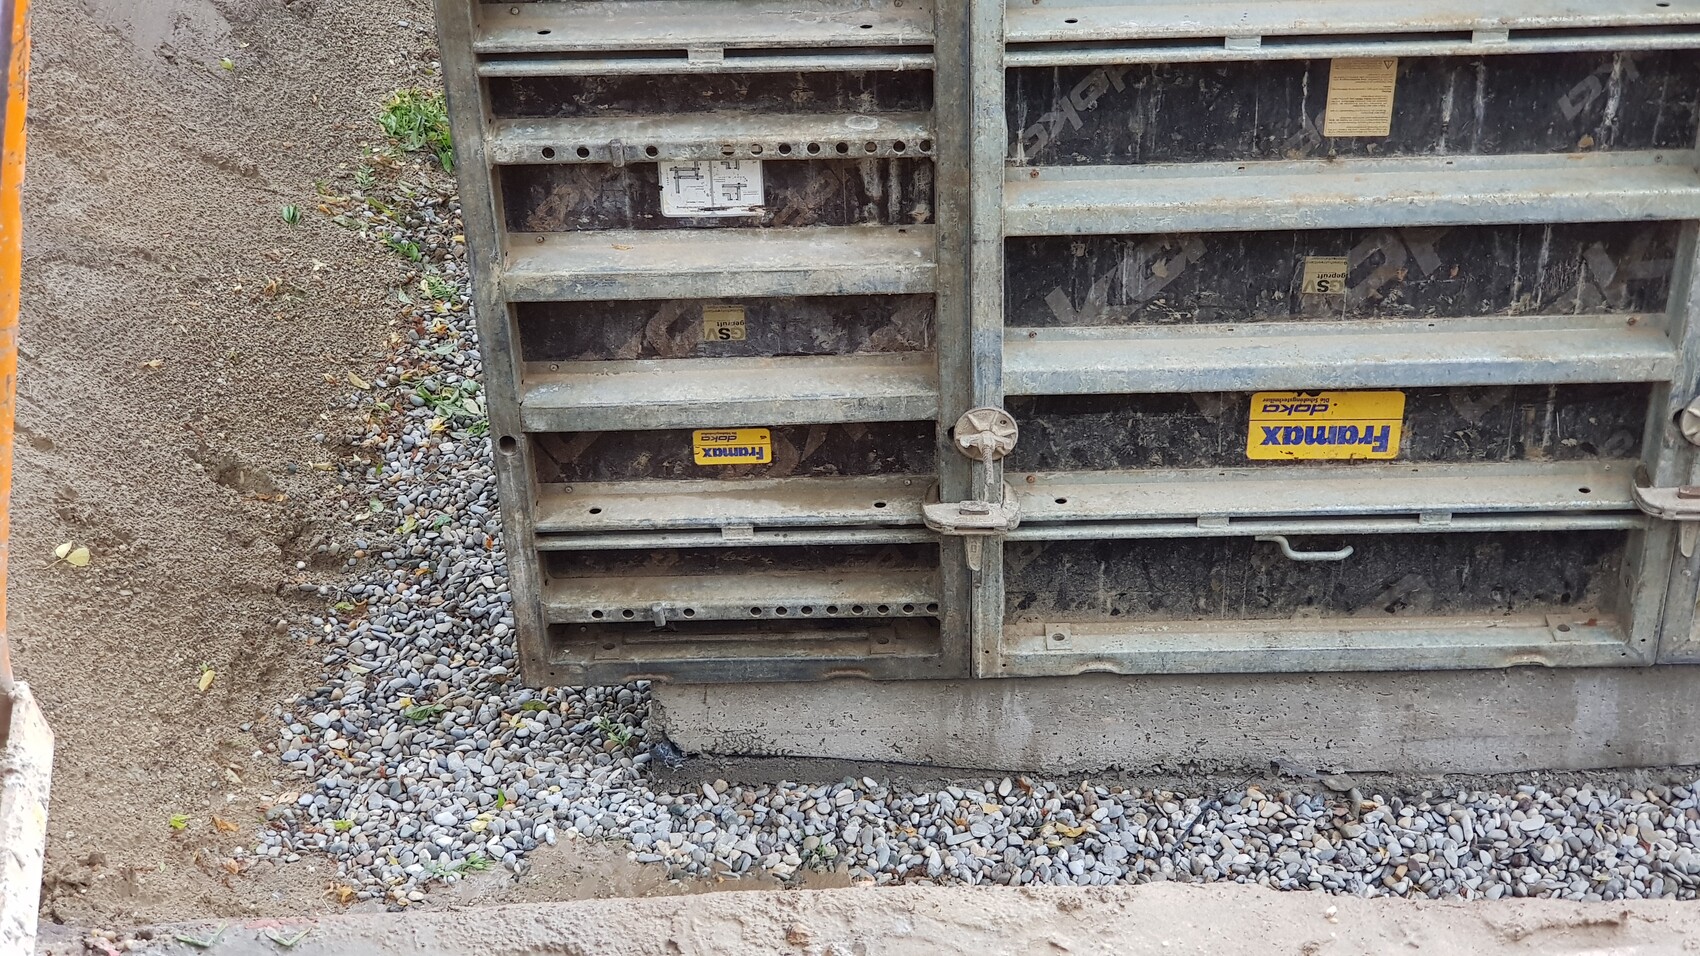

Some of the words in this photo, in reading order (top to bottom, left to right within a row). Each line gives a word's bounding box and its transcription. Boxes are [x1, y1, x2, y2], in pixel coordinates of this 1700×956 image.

[705, 327, 745, 340] GSV
[1262, 403, 1330, 416] doka
[1260, 425, 1391, 452] Framax
[702, 446, 764, 460] Framax
